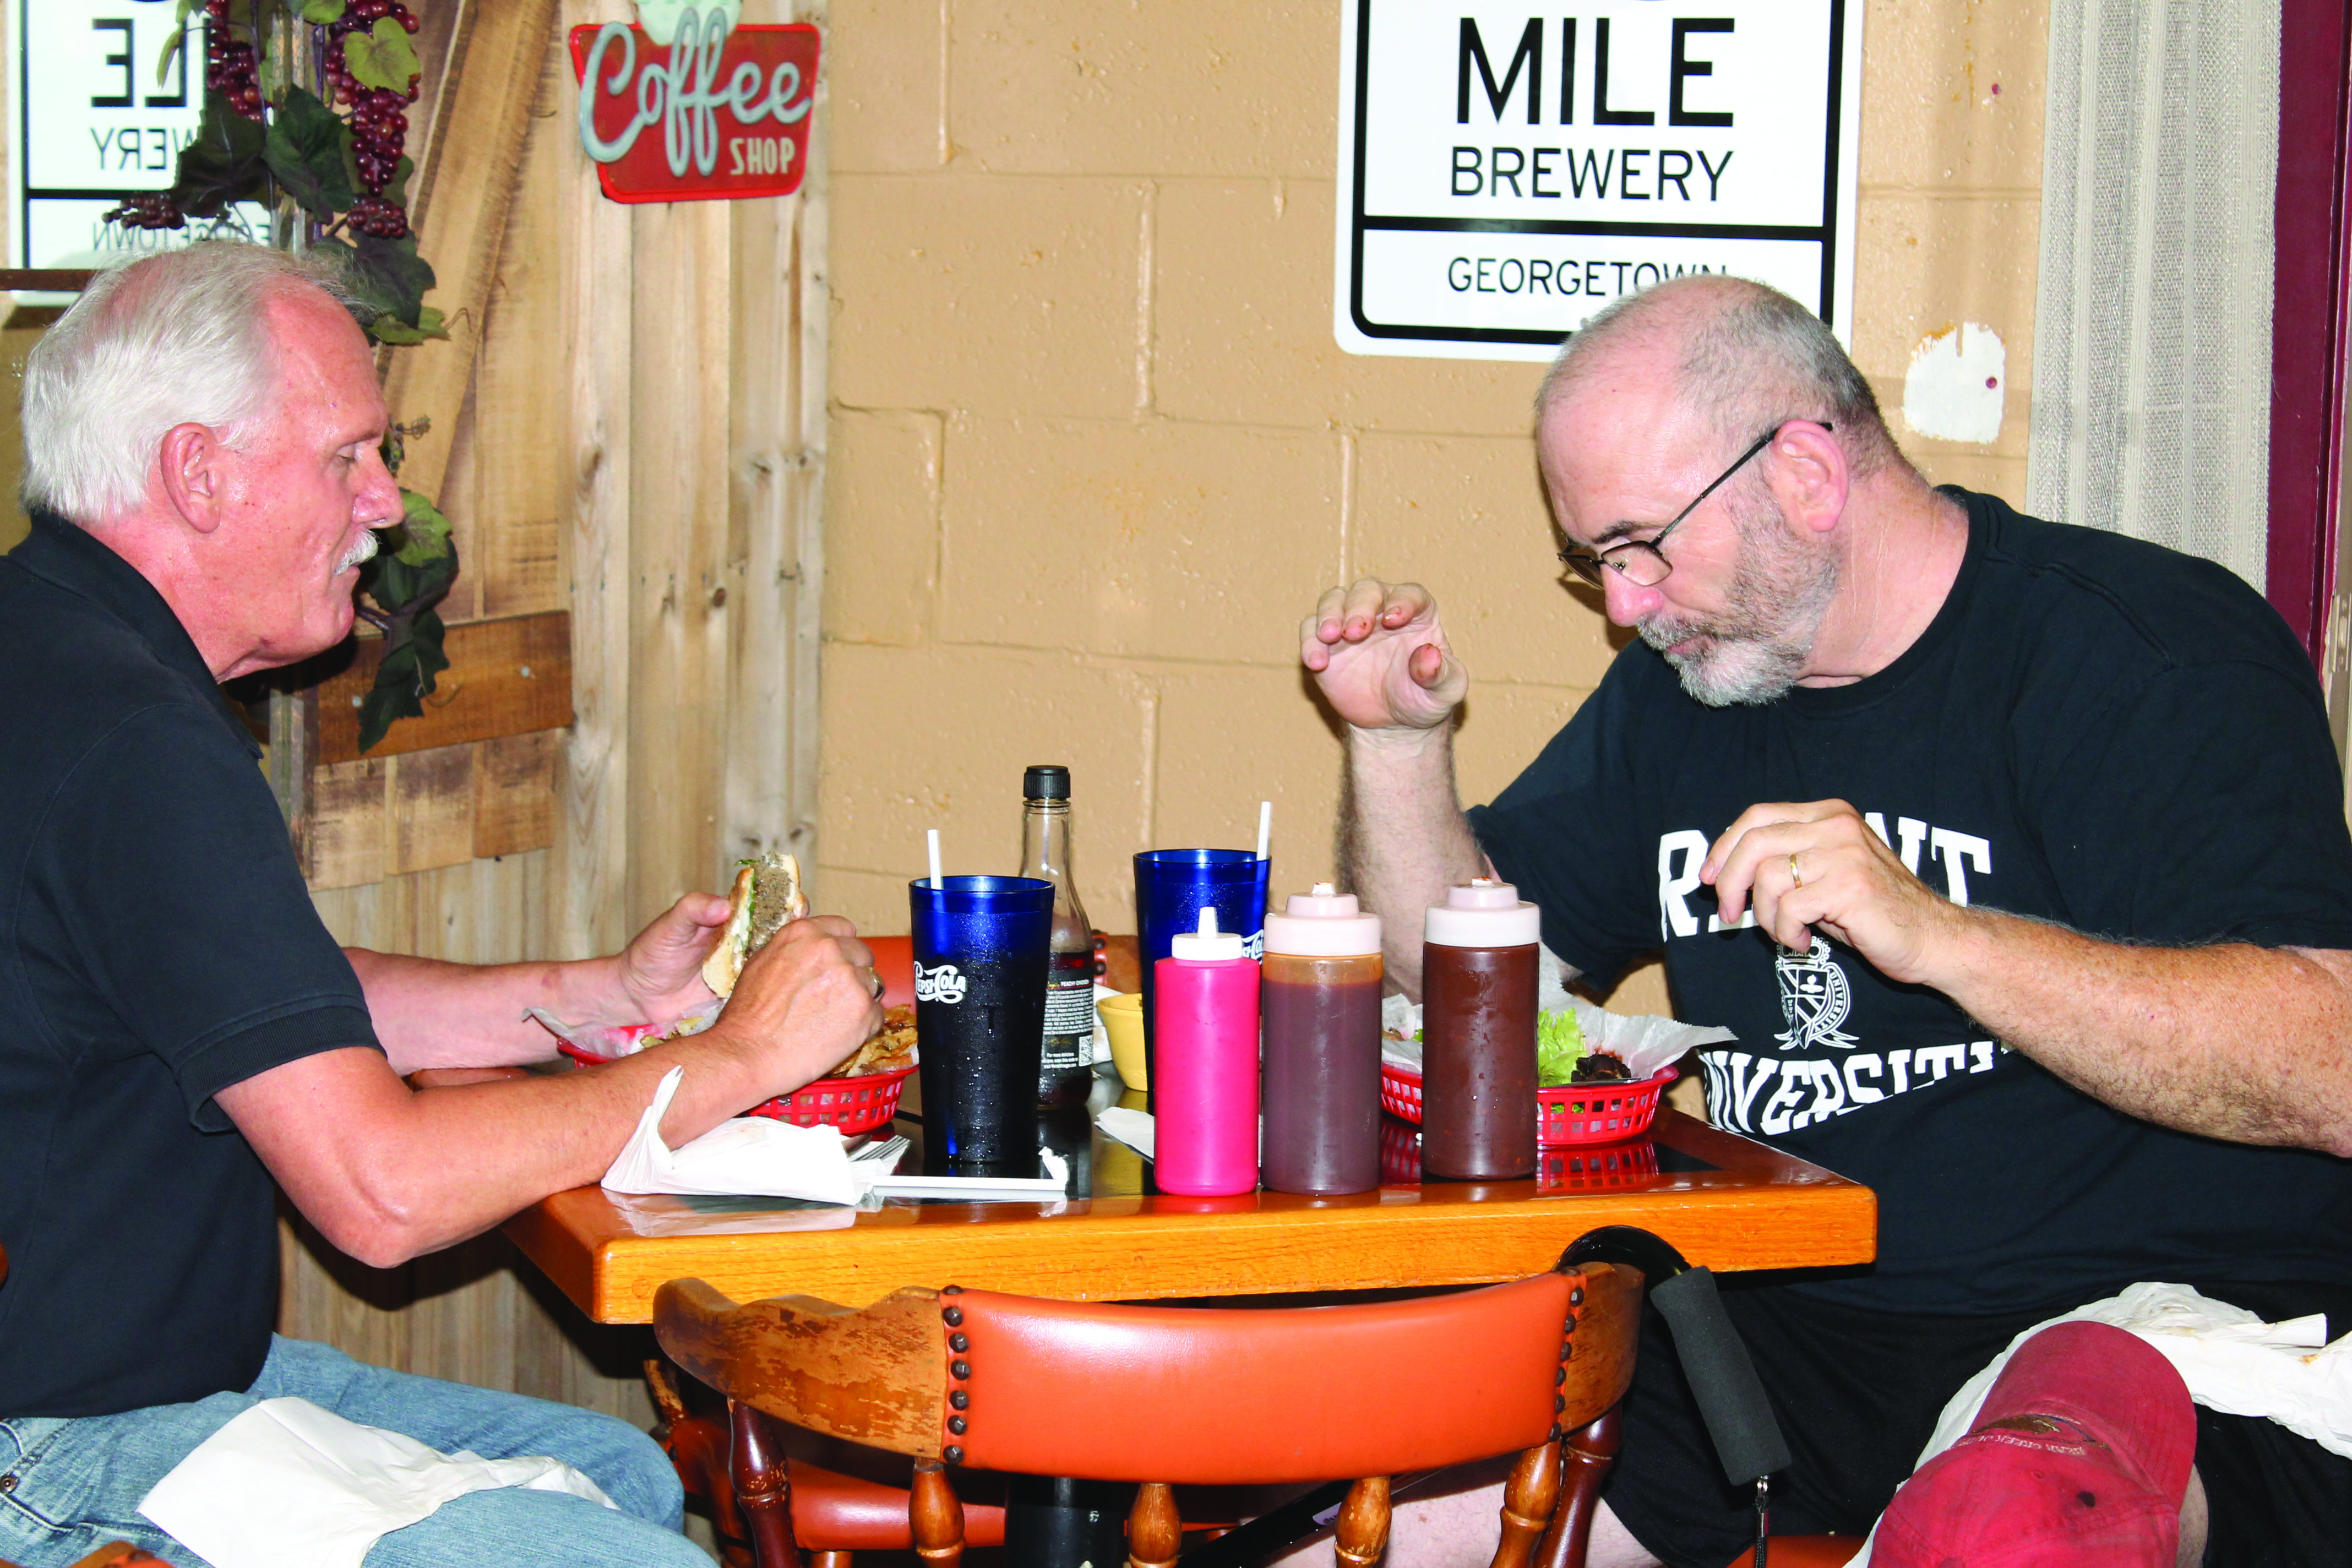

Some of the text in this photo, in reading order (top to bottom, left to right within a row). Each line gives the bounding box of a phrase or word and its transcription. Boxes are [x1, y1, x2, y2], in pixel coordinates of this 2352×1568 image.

[578, 7, 812, 177] Coffee
[1457, 17, 1735, 127] MILE
[730, 137, 795, 176] SHOP
[1451, 146, 1734, 202] BREWERY
[1449, 257, 1727, 296] GEORGETO
[1815, 971, 1844, 1032] UNIVERSITY
